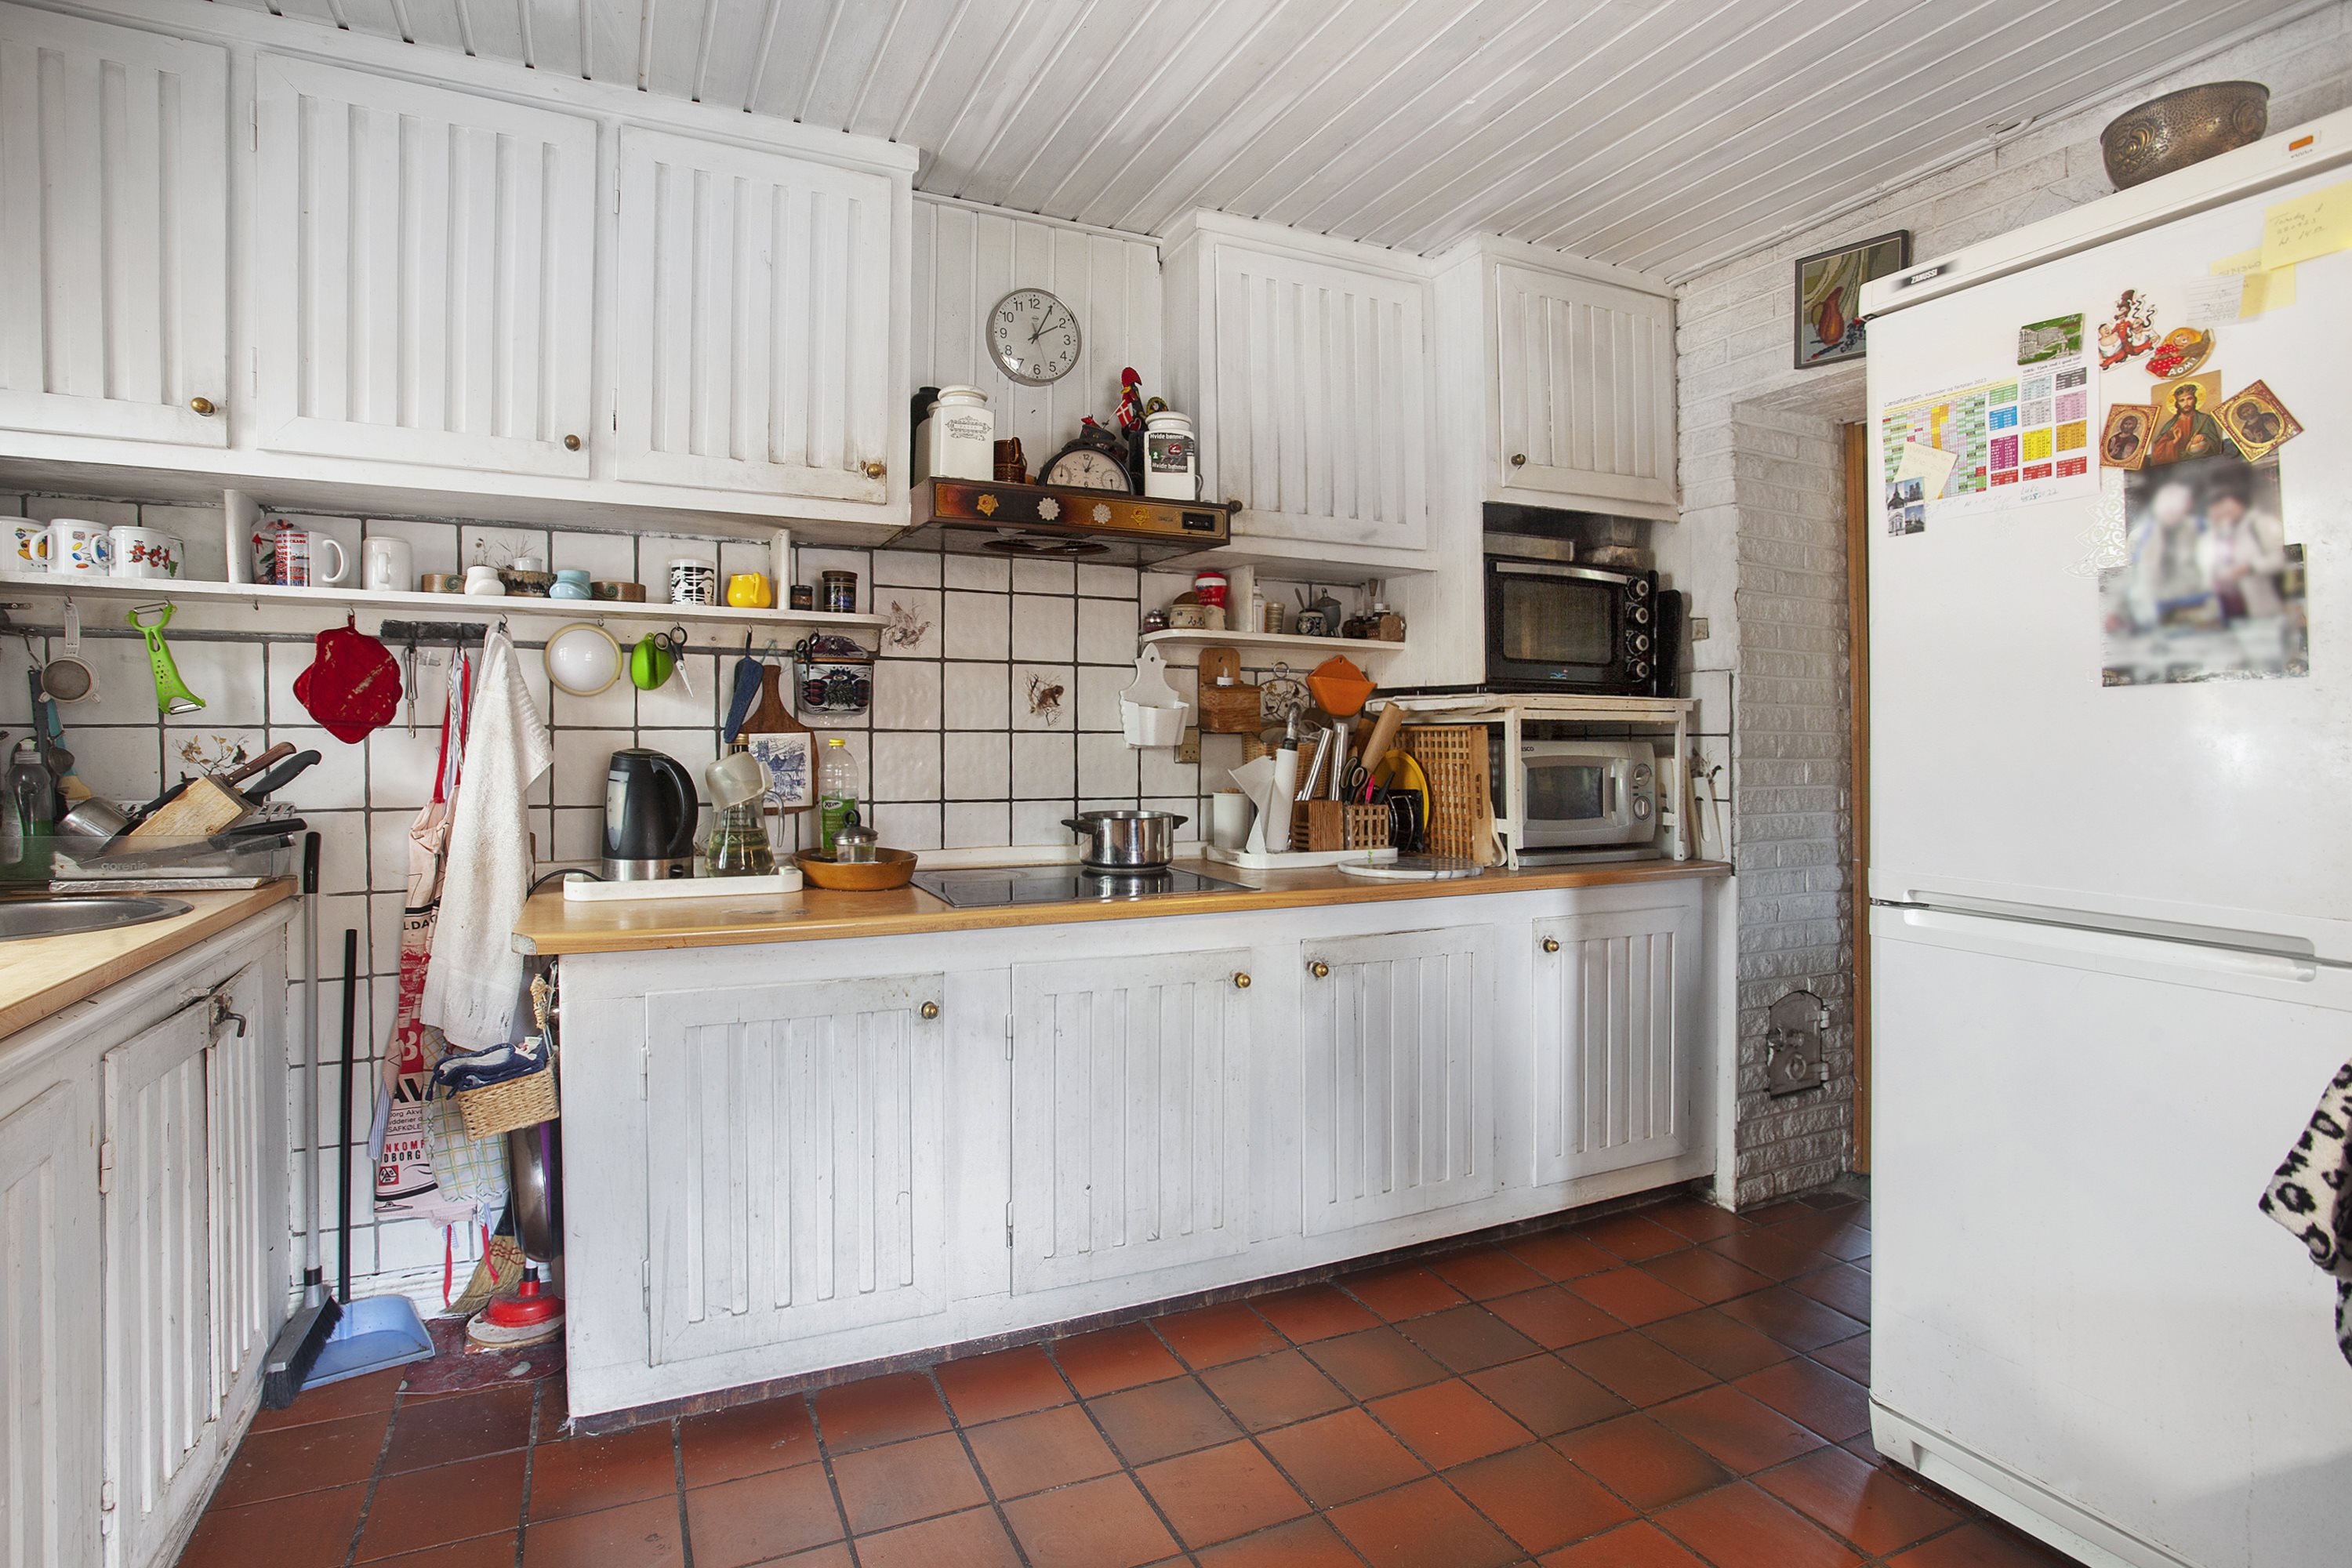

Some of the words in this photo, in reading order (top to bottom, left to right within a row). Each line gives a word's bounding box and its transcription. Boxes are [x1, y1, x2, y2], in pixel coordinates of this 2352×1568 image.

[1911, 268, 1938, 284] ZANUSSI
[1014, 301, 1023, 312] 11
[1029, 298, 1040, 310] 12
[1003, 312, 1014, 323] 10
[1058, 318, 1066, 328] 2
[1000, 328, 1007, 339] 9
[1063, 335, 1071, 345] 3
[1004, 345, 1012, 356] 8
[1060, 351, 1067, 361] 4
[1017, 358, 1025, 369] 7
[1049, 361, 1057, 372] 5
[1033, 364, 1041, 376] 6
[384, 1149, 420, 1163] DBORG
